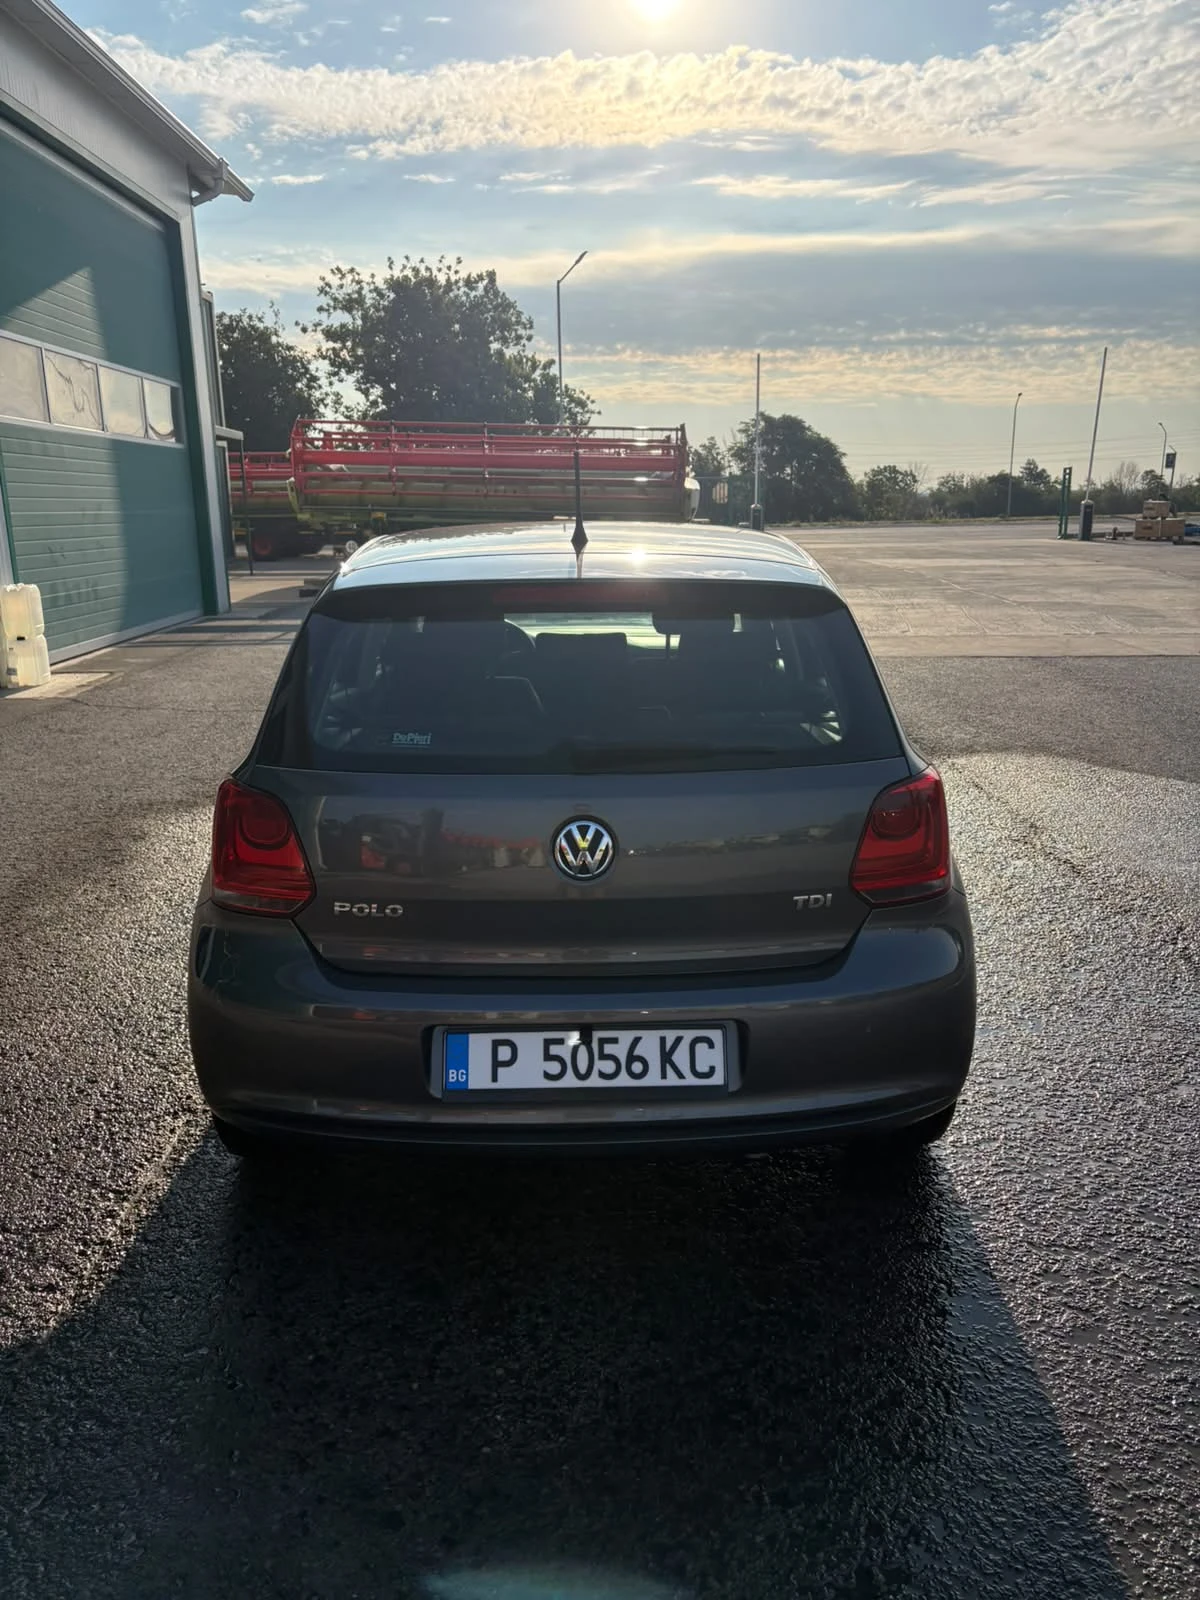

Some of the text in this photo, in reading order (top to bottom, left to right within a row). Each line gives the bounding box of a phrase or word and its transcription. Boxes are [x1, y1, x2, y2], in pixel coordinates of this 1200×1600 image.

[556, 820, 612, 876] VW
[334, 901, 404, 918] POLO
[793, 893, 833, 910] TDI
[491, 1038, 518, 1083] P
[448, 1069, 467, 1082] BG
